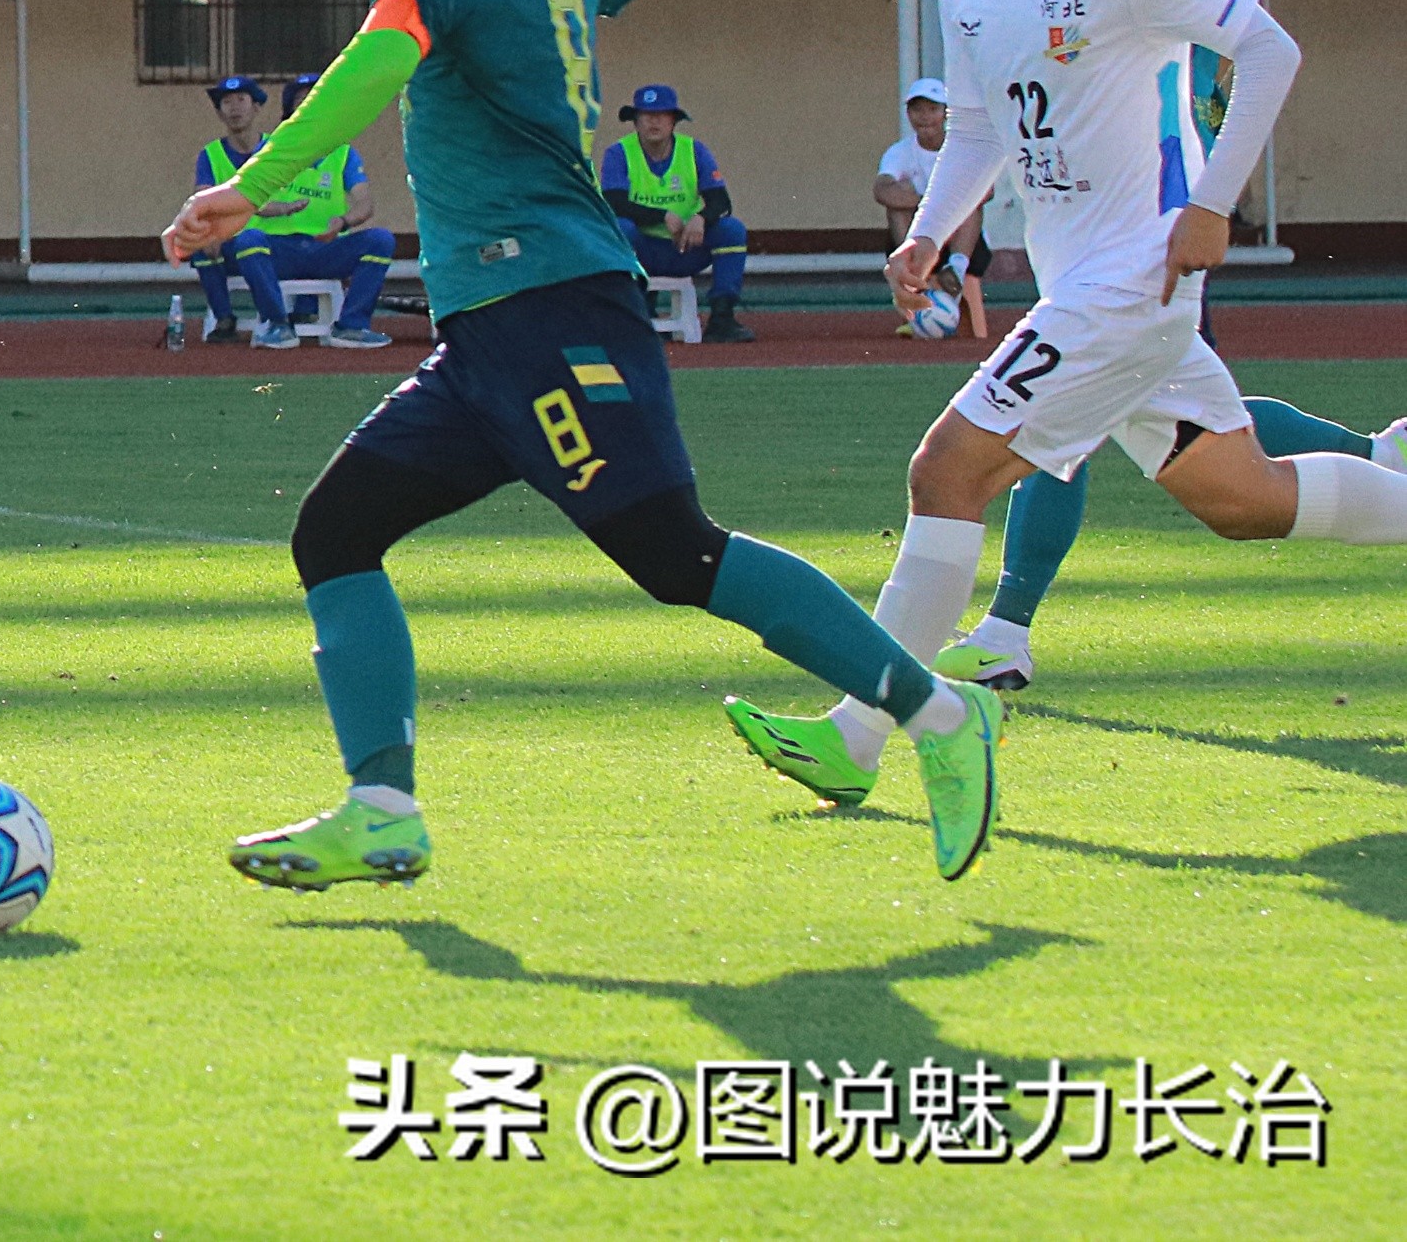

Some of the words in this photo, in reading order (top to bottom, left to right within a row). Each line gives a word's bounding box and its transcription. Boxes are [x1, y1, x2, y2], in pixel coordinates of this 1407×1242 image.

[1007, 81, 1054, 140] 12
[992, 329, 1061, 402] 12
[534, 389, 592, 468] 8
